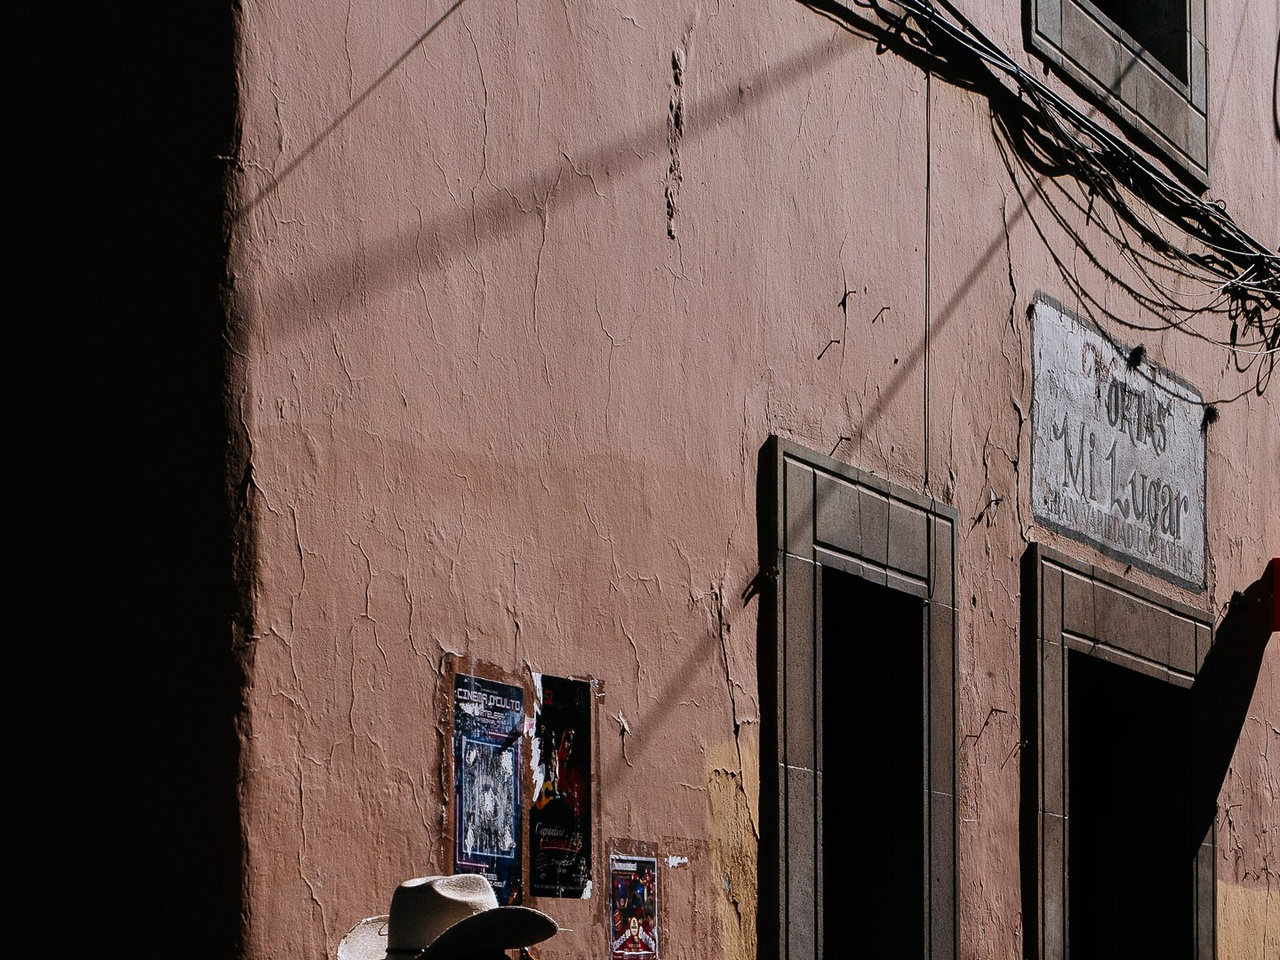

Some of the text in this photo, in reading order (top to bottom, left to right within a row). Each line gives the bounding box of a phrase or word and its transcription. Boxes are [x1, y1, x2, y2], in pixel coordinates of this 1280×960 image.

[1052, 412, 1189, 553] Mi Lugar
[457, 687, 488, 705] CINEMA
